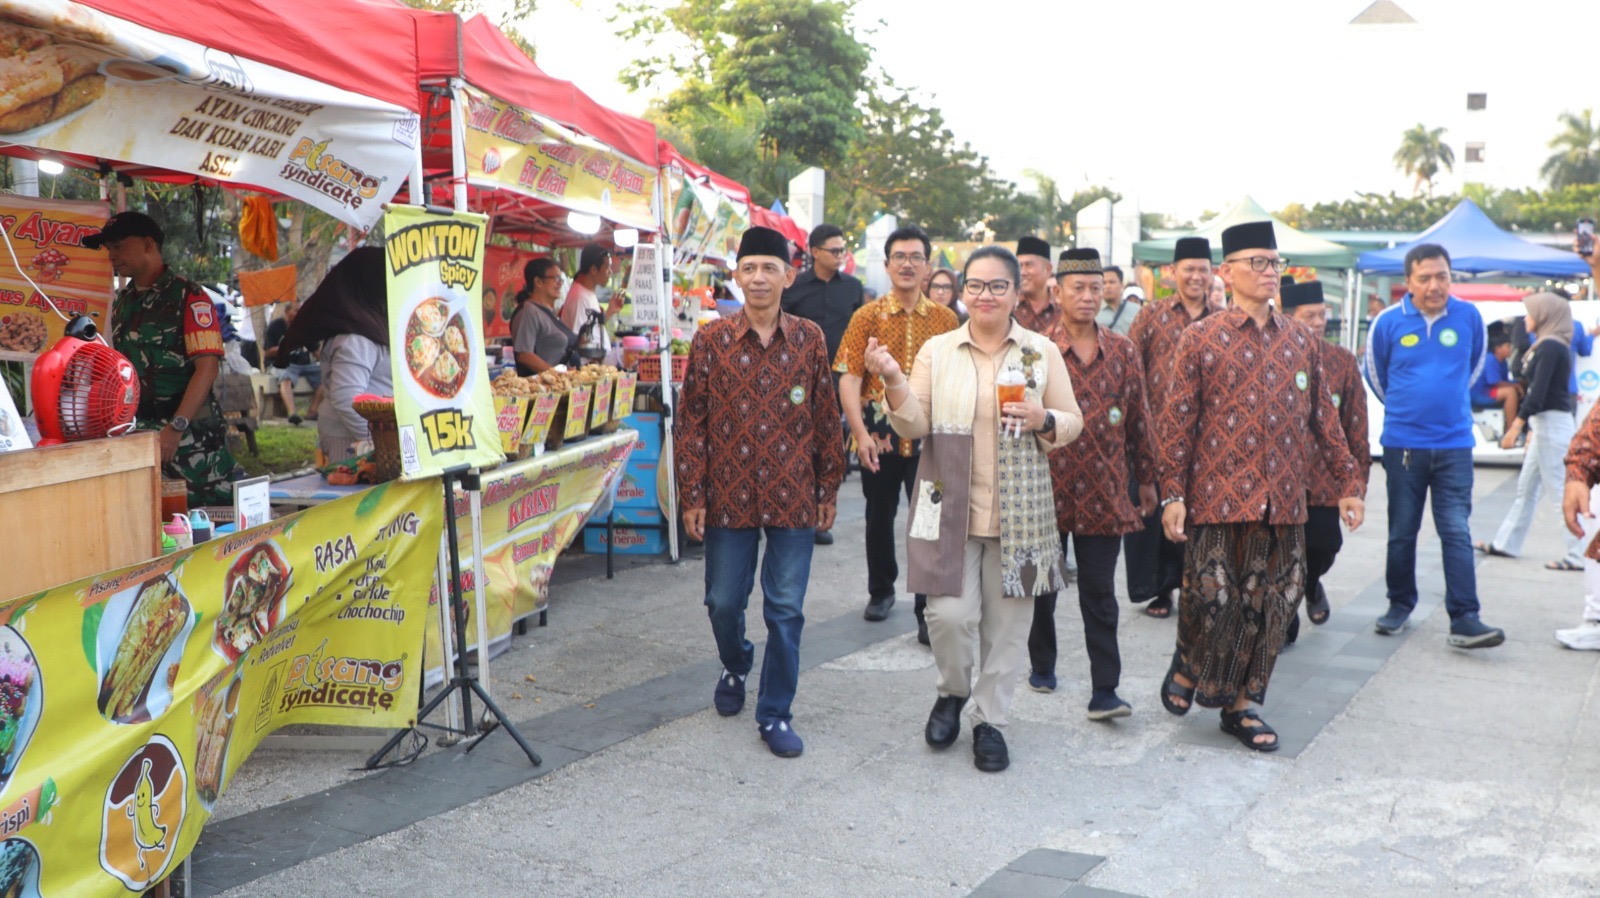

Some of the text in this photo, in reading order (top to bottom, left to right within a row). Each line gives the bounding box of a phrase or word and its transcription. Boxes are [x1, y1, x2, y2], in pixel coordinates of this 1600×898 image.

[195, 95, 244, 121] AYAM
[242, 109, 303, 137] CINCANG
[169, 117, 286, 159] DAN KUAH KARI
[279, 162, 363, 209] syndicate
[518, 155, 568, 197] Bu Dian
[609, 160, 644, 194] Ayam
[388, 221, 479, 275] WONTON
[440, 260, 478, 290] Spicy
[28, 294, 88, 313] Ayam
[420, 409, 476, 455] 15k
[314, 535, 357, 572] RASA
[600, 533, 646, 544] Mnerale
[89, 577, 123, 597] Pisang
[279, 682, 394, 712] syndicate
